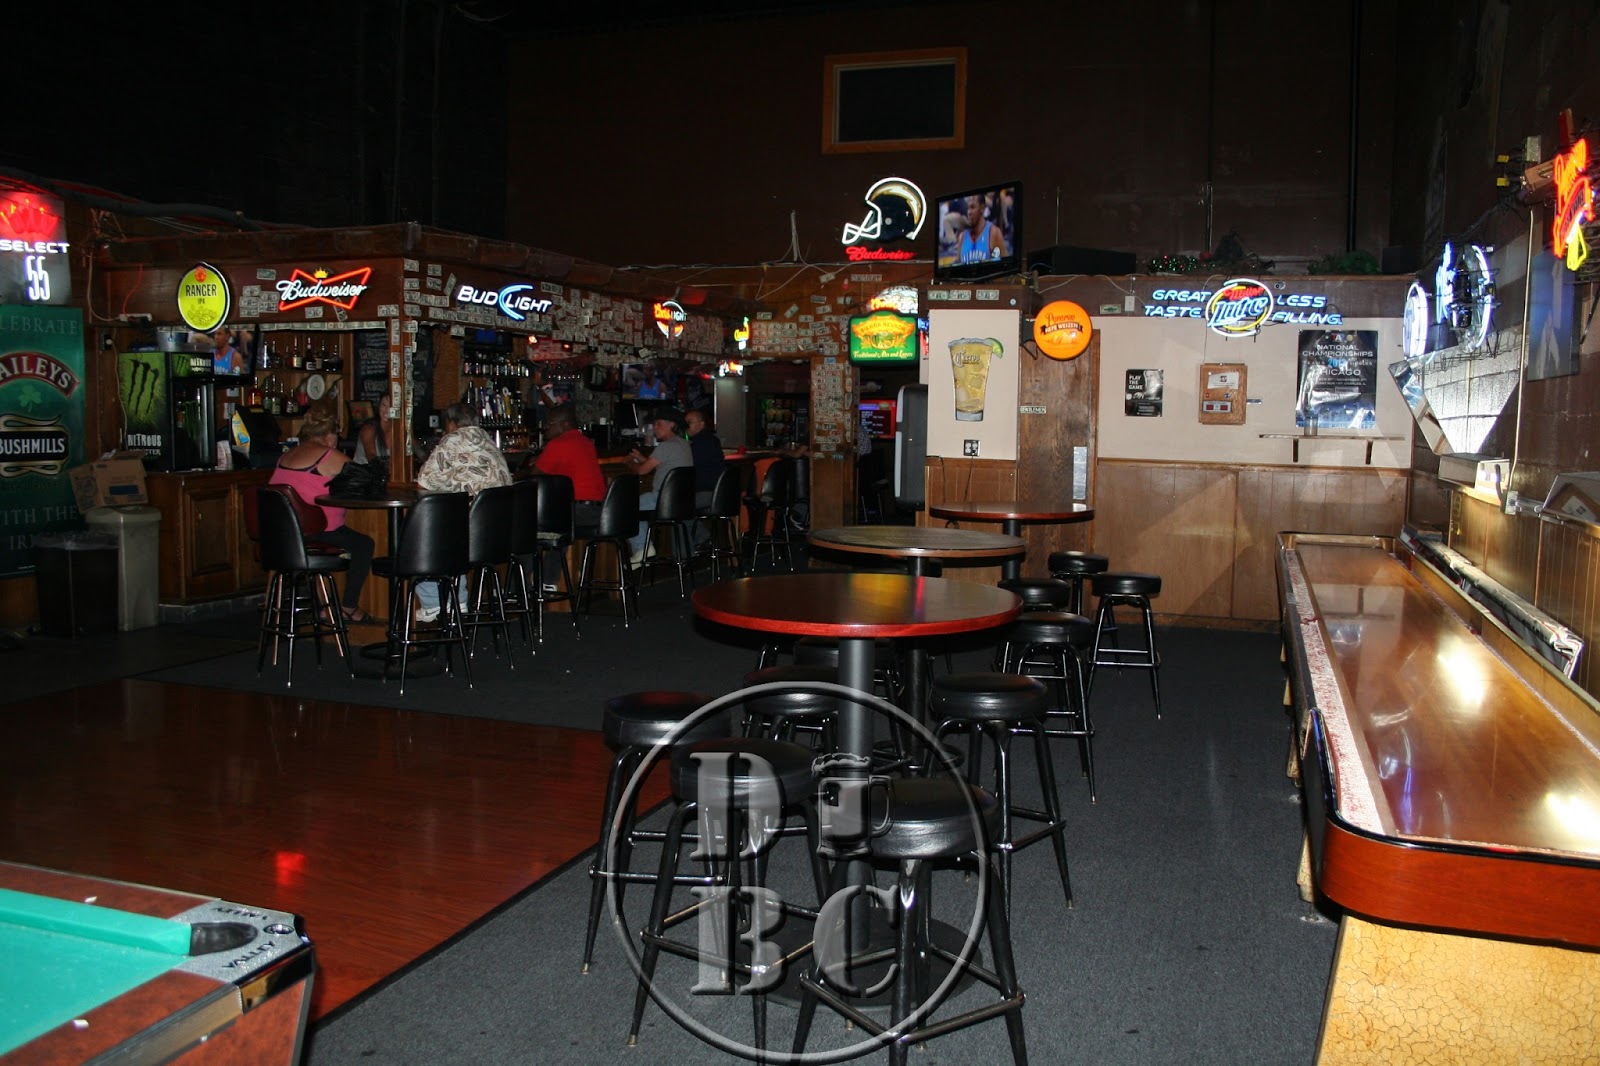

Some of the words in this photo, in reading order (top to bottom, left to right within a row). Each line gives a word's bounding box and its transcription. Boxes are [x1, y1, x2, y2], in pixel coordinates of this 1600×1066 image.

[0, 239, 70, 253] SELECT
[845, 246, 917, 260] Budweiser
[26, 255, 50, 300] 55
[185, 284, 217, 297] RANGER
[276, 280, 367, 300] Budweiser
[1152, 290, 1212, 302] GREAT
[457, 285, 498, 305] BUD
[505, 293, 552, 312] LIGHT
[1276, 295, 1326, 308] LESS
[1144, 306, 1202, 318] TASTE
[128, 434, 162, 446] NITROUS
